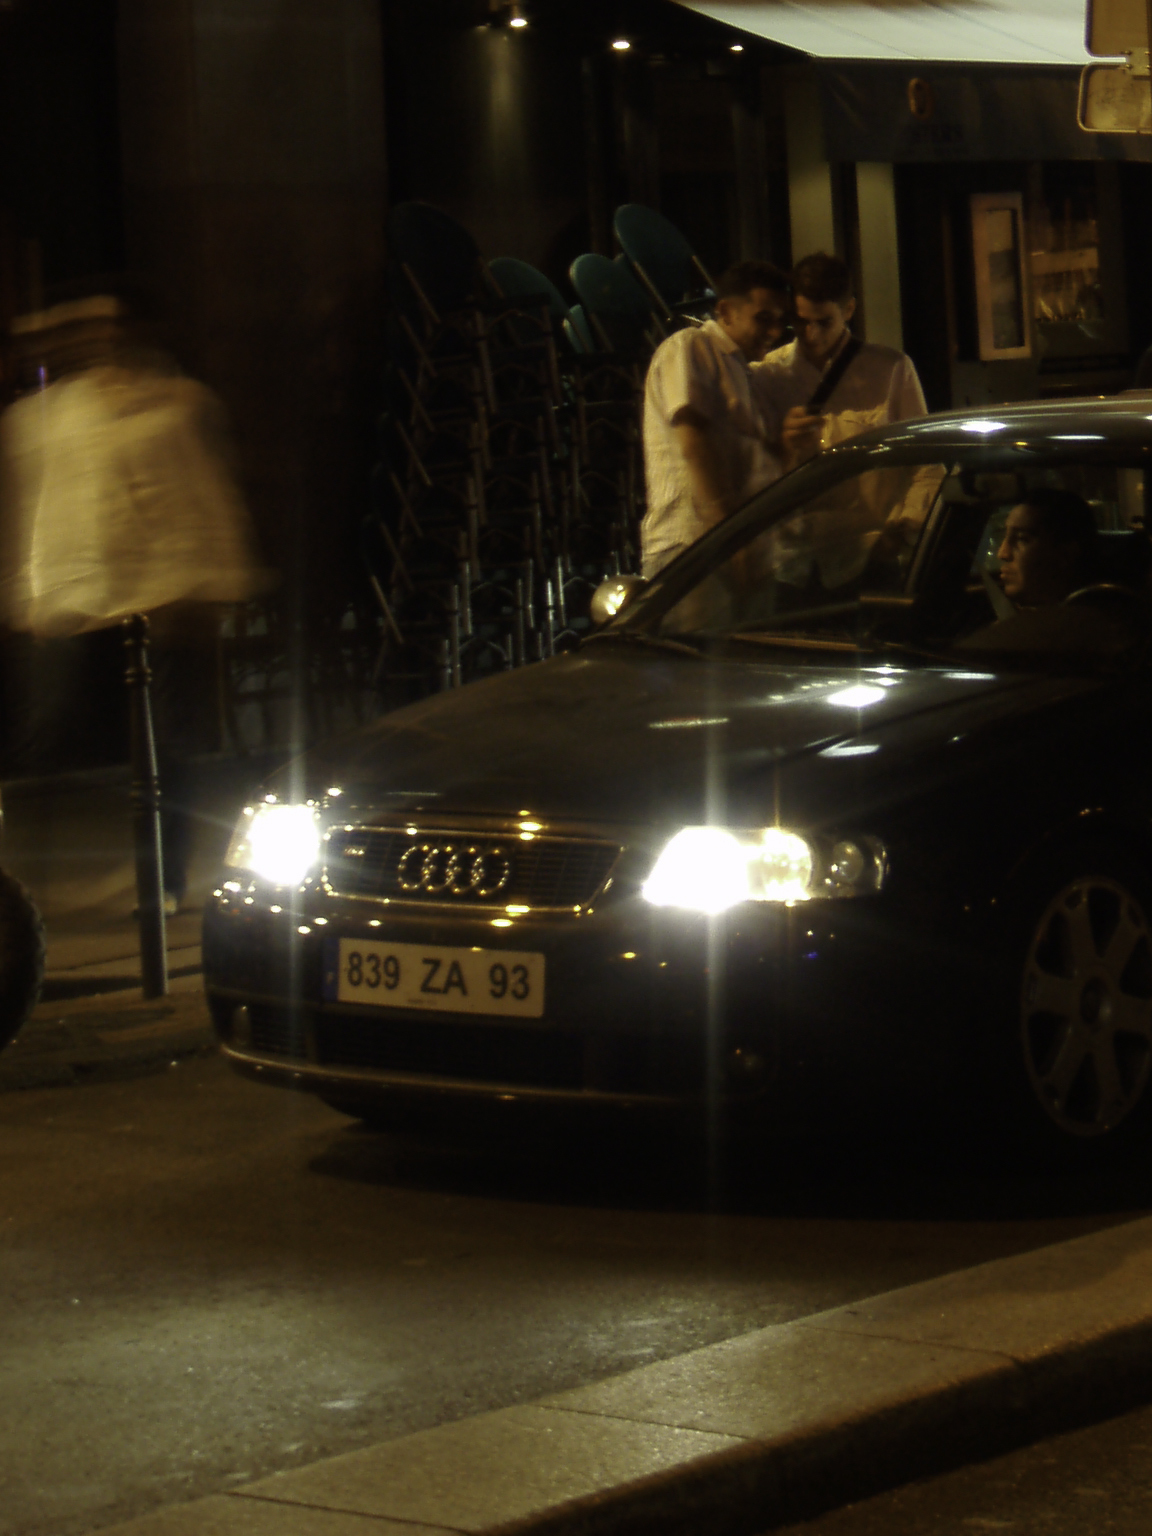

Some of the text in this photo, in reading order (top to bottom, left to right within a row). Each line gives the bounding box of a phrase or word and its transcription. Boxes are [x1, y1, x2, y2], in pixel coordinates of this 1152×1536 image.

[347, 951, 530, 1001] 839 ZA 93
